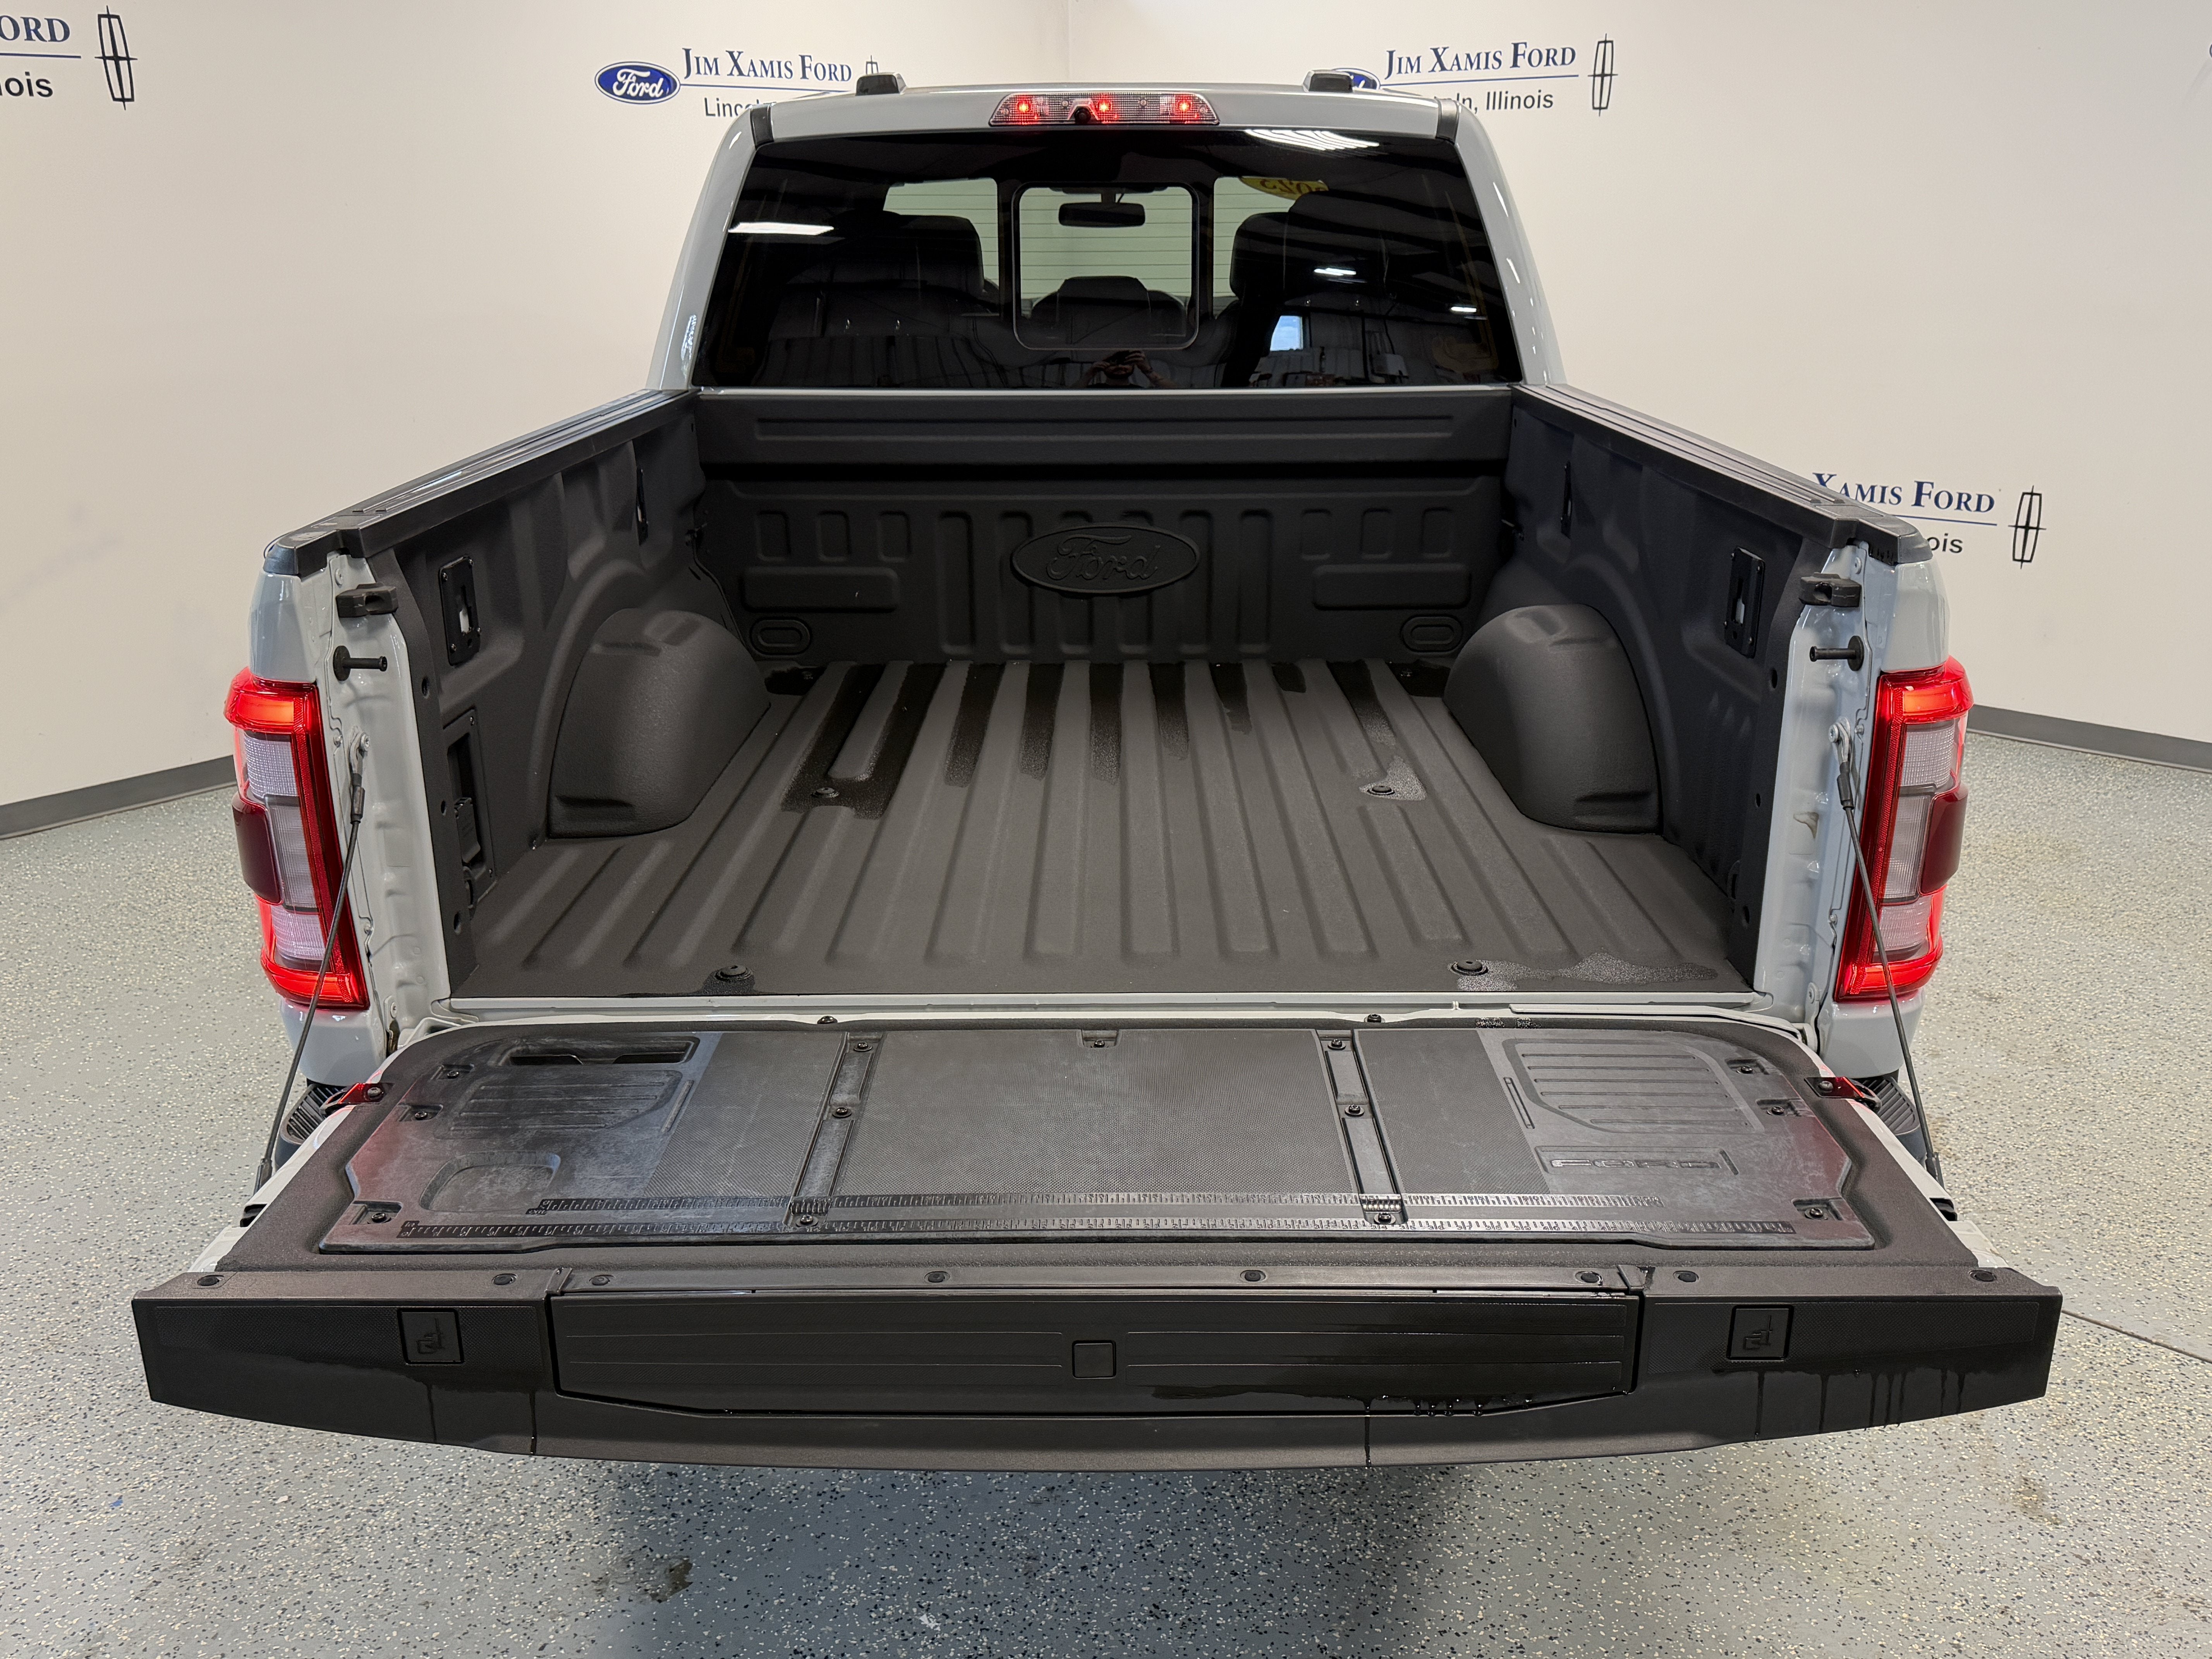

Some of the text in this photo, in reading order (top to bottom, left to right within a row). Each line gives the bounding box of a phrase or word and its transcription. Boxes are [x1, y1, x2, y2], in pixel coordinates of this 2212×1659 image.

[0, 71, 53, 97] ois
[613, 68, 664, 98] Ford
[704, 98, 759, 117] Linc
[1486, 89, 1553, 110] Illinois
[1046, 533, 1161, 580] Ford
[1551, 1159, 1722, 1169] FORD
